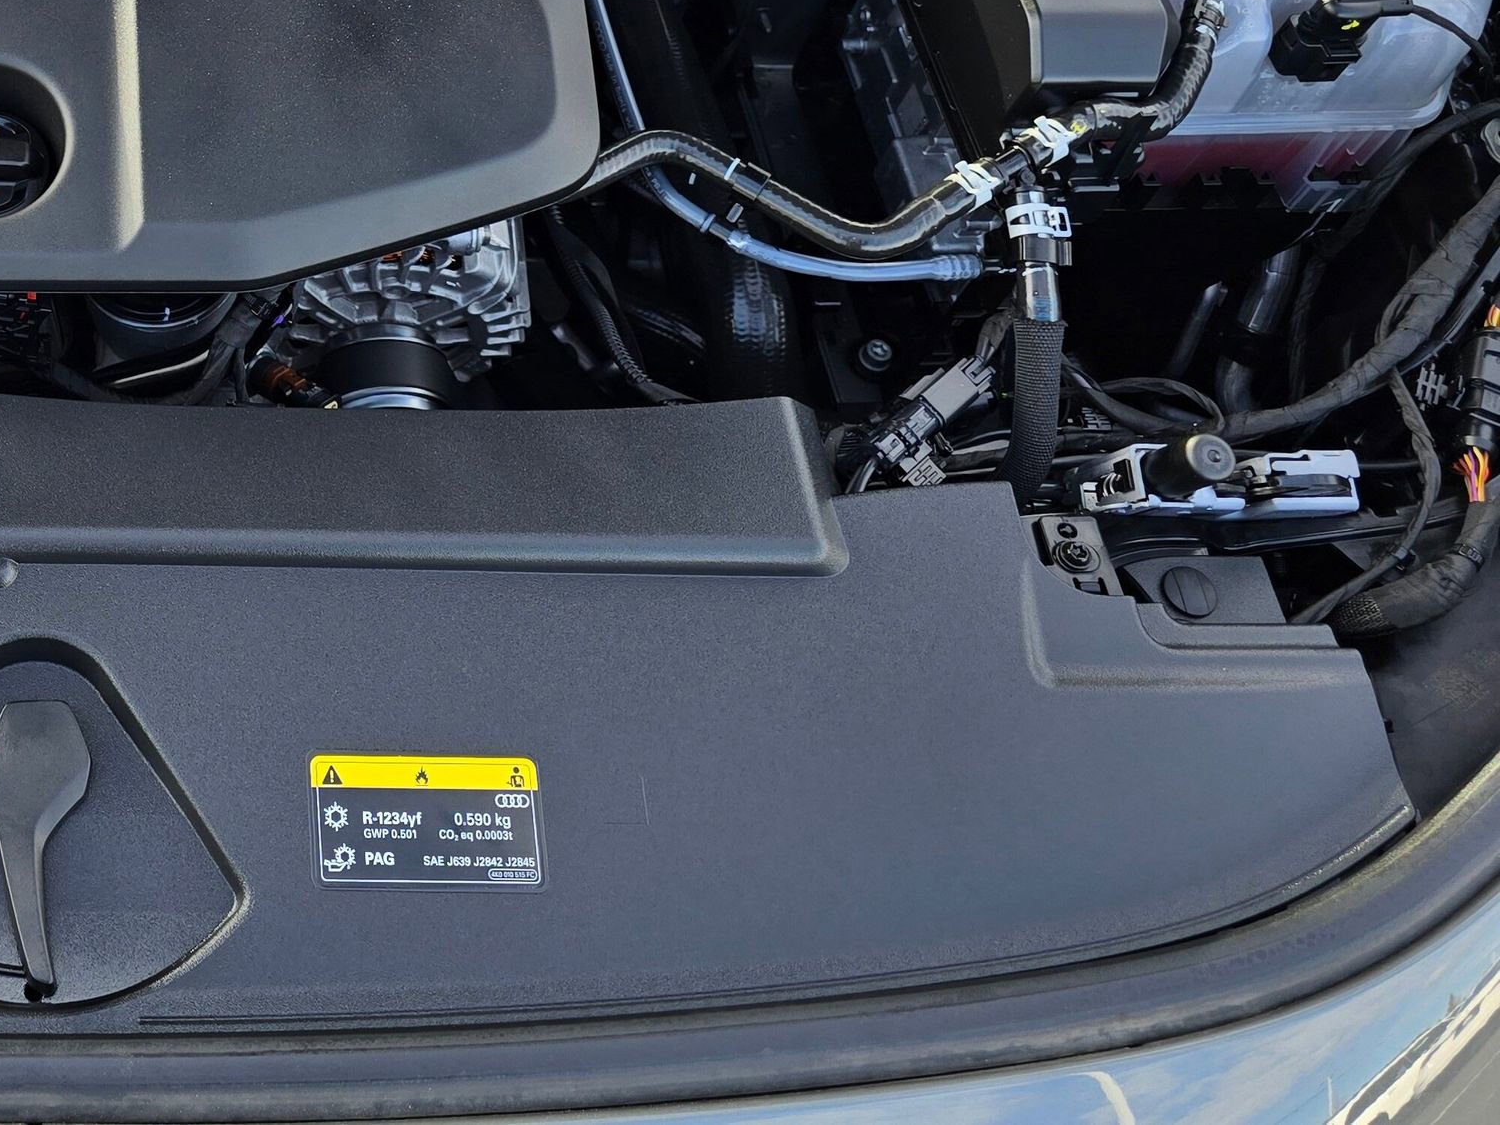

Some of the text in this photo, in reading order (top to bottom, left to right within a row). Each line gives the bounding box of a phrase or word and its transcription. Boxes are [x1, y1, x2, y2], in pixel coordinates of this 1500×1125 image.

[362, 811, 422, 828] R-1234yf
[454, 813, 512, 829] 0.590 kg
[364, 828, 417, 839] GWP 0.501
[460, 831, 474, 842] eq
[476, 830, 514, 841] 0.0003t
[364, 851, 396, 866] PAG
[423, 855, 536, 867] SAE J639 J2842 J2845
